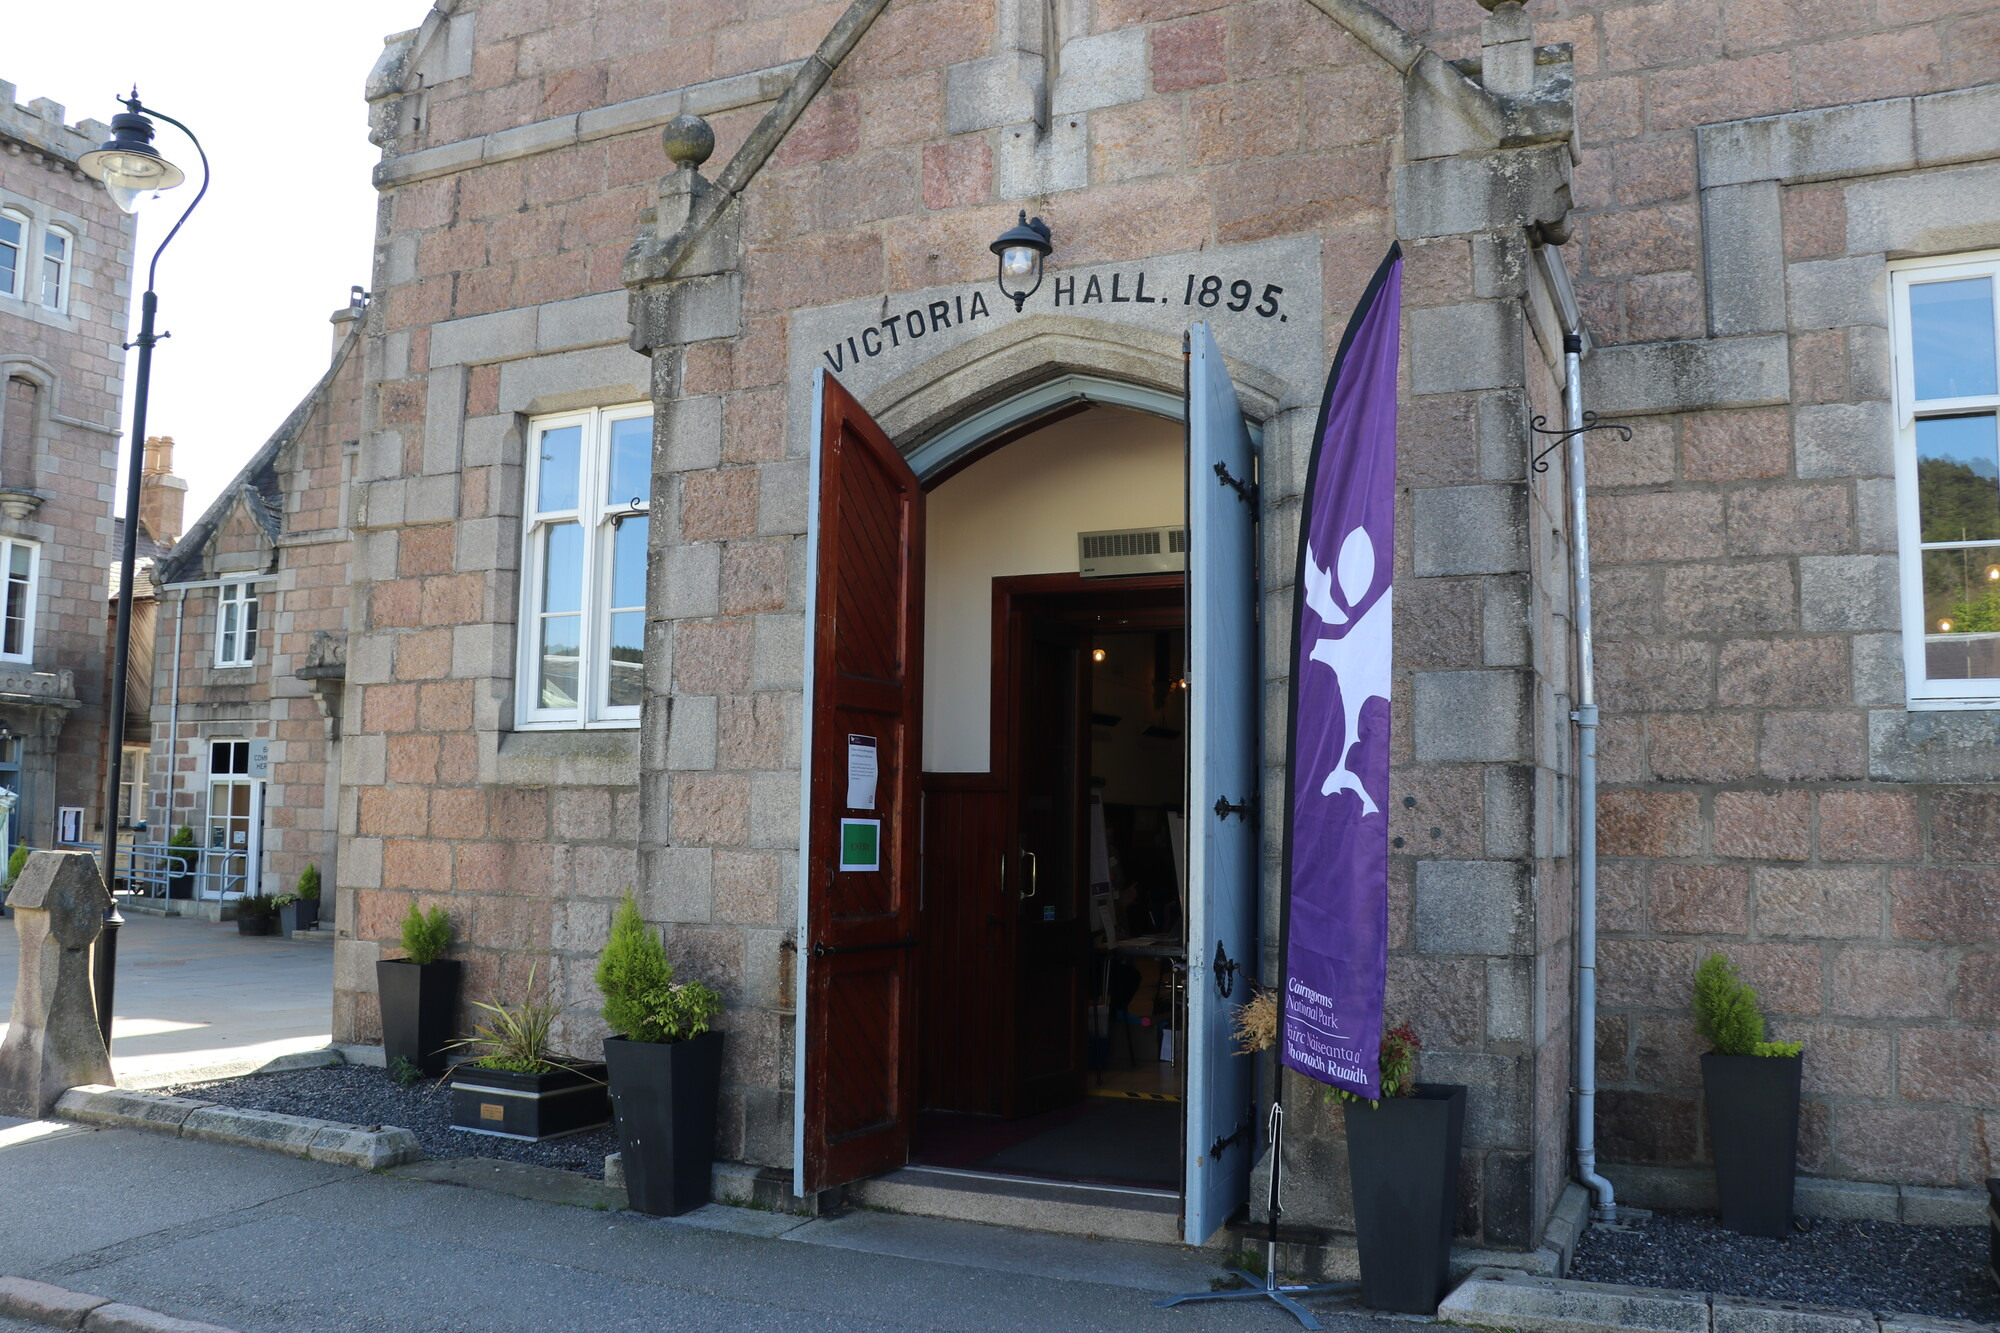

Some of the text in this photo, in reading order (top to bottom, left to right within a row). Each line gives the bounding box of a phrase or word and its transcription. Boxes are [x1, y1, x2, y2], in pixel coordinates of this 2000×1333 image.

[823, 272, 1288, 373] VICTORIA HALL, 1895.
[850, 842, 870, 852] ENTRY
[1288, 977, 1333, 1009] Cairngorms
[1286, 994, 1338, 1029] National Park
[1327, 1060, 1368, 1085] Ruaidh
